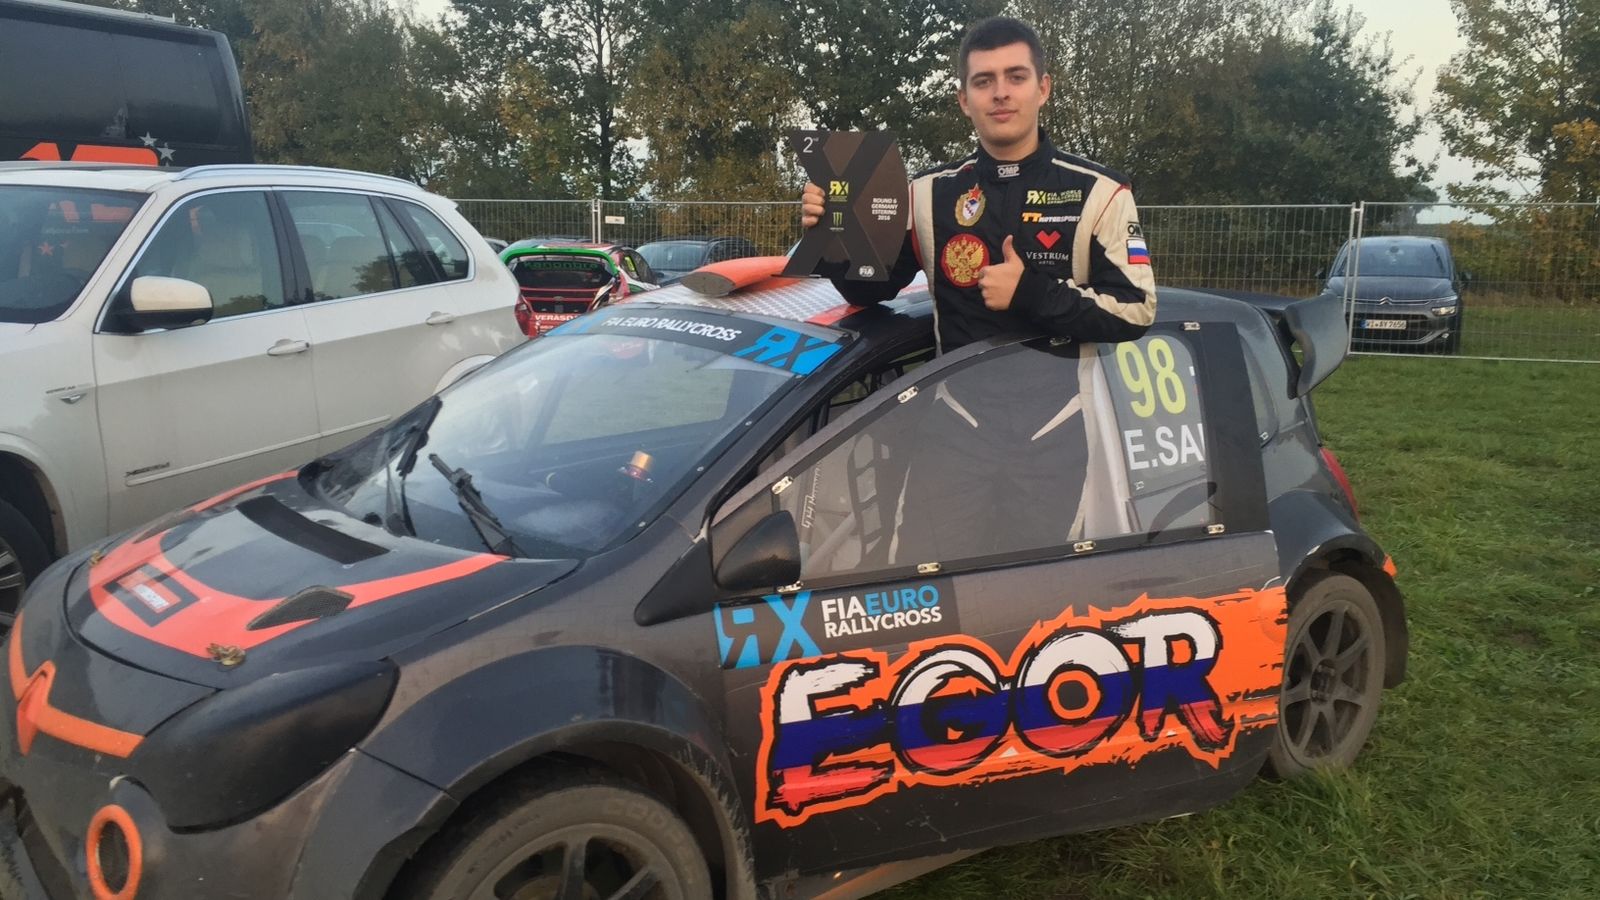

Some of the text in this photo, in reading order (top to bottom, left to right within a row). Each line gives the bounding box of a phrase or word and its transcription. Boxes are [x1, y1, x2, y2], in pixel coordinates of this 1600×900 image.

[997, 164, 1020, 178] OMP
[1026, 251, 1069, 262] VESTRUM
[858, 266, 875, 277] FIA
[535, 314, 577, 322] VERASO
[602, 317, 742, 341] FIA EURO RALLYCROSS
[1115, 337, 1187, 418] 98
[1123, 423, 1206, 470] E.SA
[824, 605, 943, 638] RALLYCROSS
[767, 608, 1234, 816] EGOR
